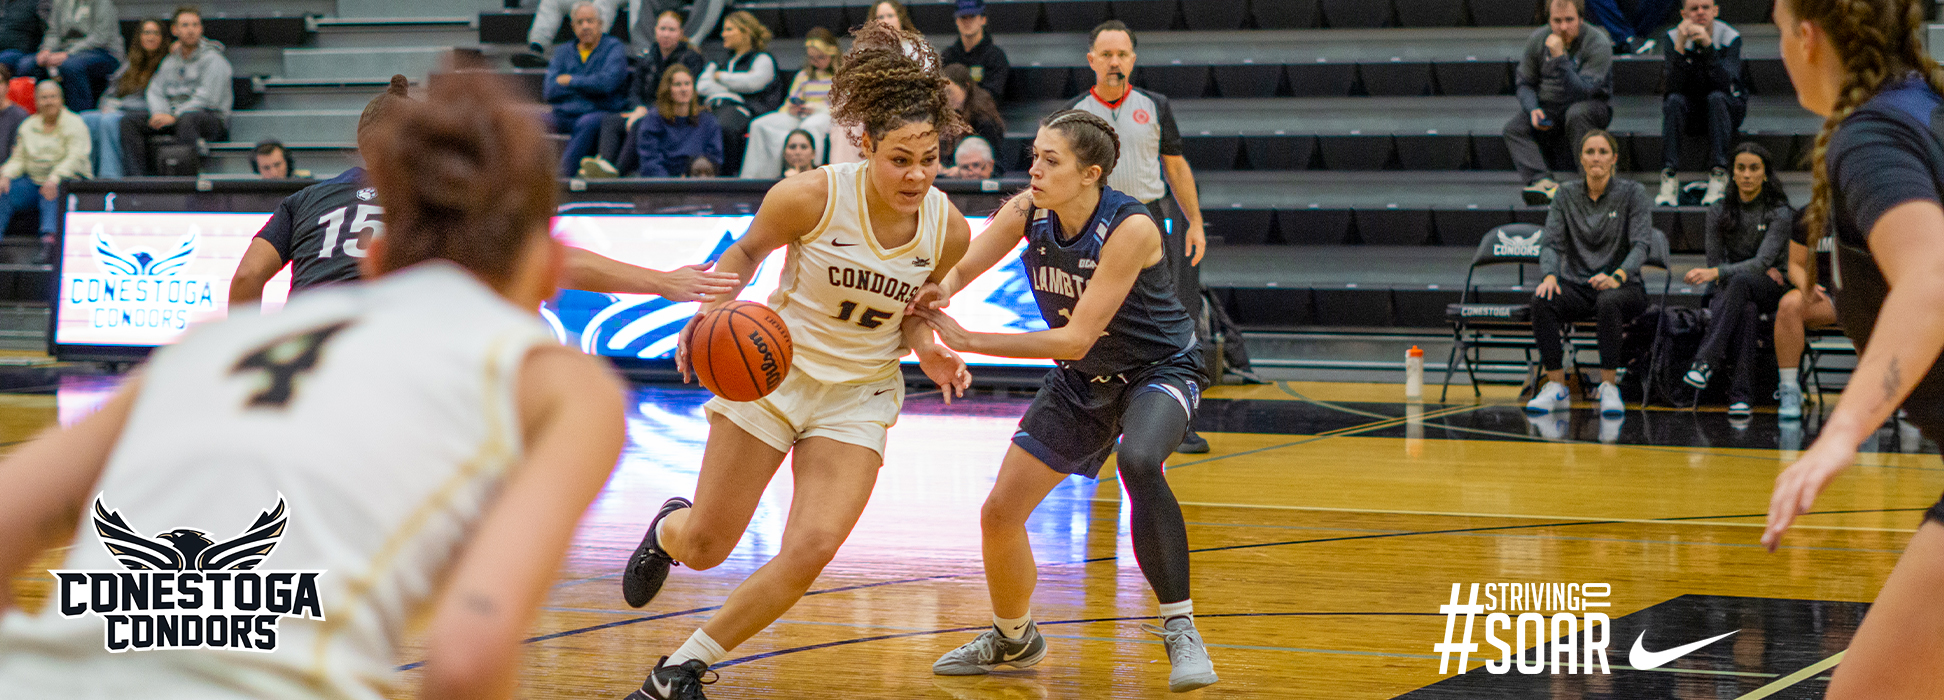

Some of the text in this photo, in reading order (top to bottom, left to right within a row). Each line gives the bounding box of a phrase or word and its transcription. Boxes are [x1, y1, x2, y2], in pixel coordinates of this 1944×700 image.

[318, 204, 386, 258] 15
[1494, 244, 1540, 256] CONDORS
[71, 278, 213, 307] CONESTOGA
[828, 266, 919, 303] CONDORS
[94, 308, 187, 329] CONDORS
[1461, 306, 1510, 317] CONESTOGA
[226, 318, 356, 408] 4
[748, 330, 781, 391] Wilson
